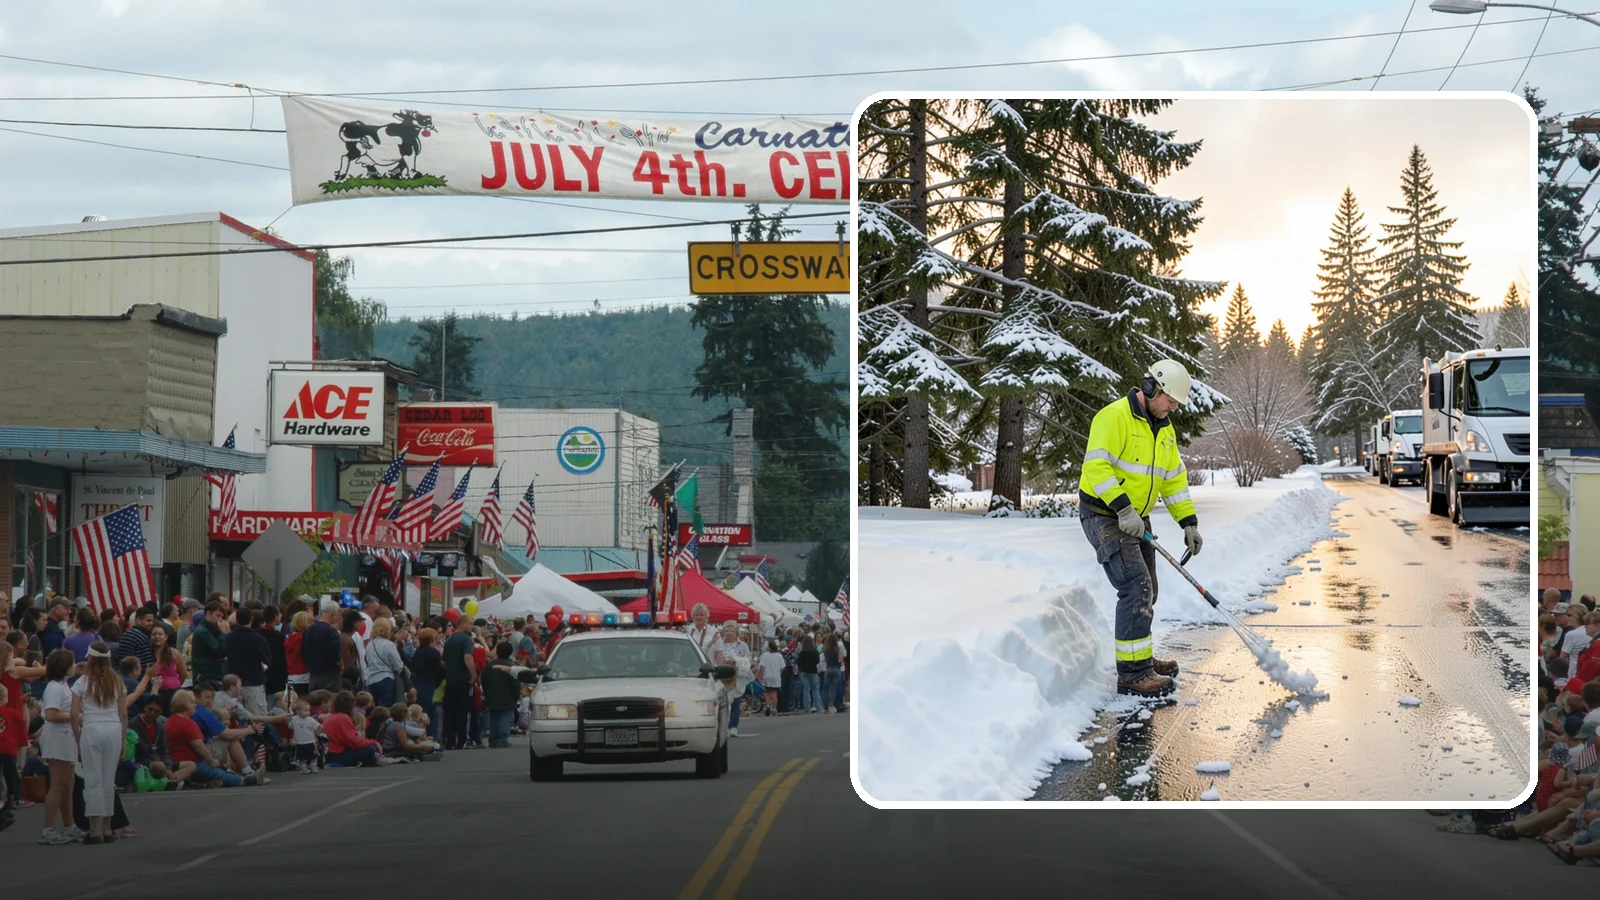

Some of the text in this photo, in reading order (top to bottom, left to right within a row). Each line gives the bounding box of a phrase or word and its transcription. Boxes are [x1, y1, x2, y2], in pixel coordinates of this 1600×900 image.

[481, 141, 604, 192] JULY
[632, 150, 746, 197] 4th.
[697, 254, 850, 280] CROSSWA
[283, 380, 373, 419] ACE
[406, 409, 485, 422] CEDAR LOG
[283, 421, 370, 436] Hardware
[416, 428, 477, 446] Coca-Cola
[354, 467, 385, 480] Simpl
[83, 485, 155, 495] St. Vincent de Paul
[688, 526, 741, 535] CRNATION
[699, 535, 730, 543] GLASS
